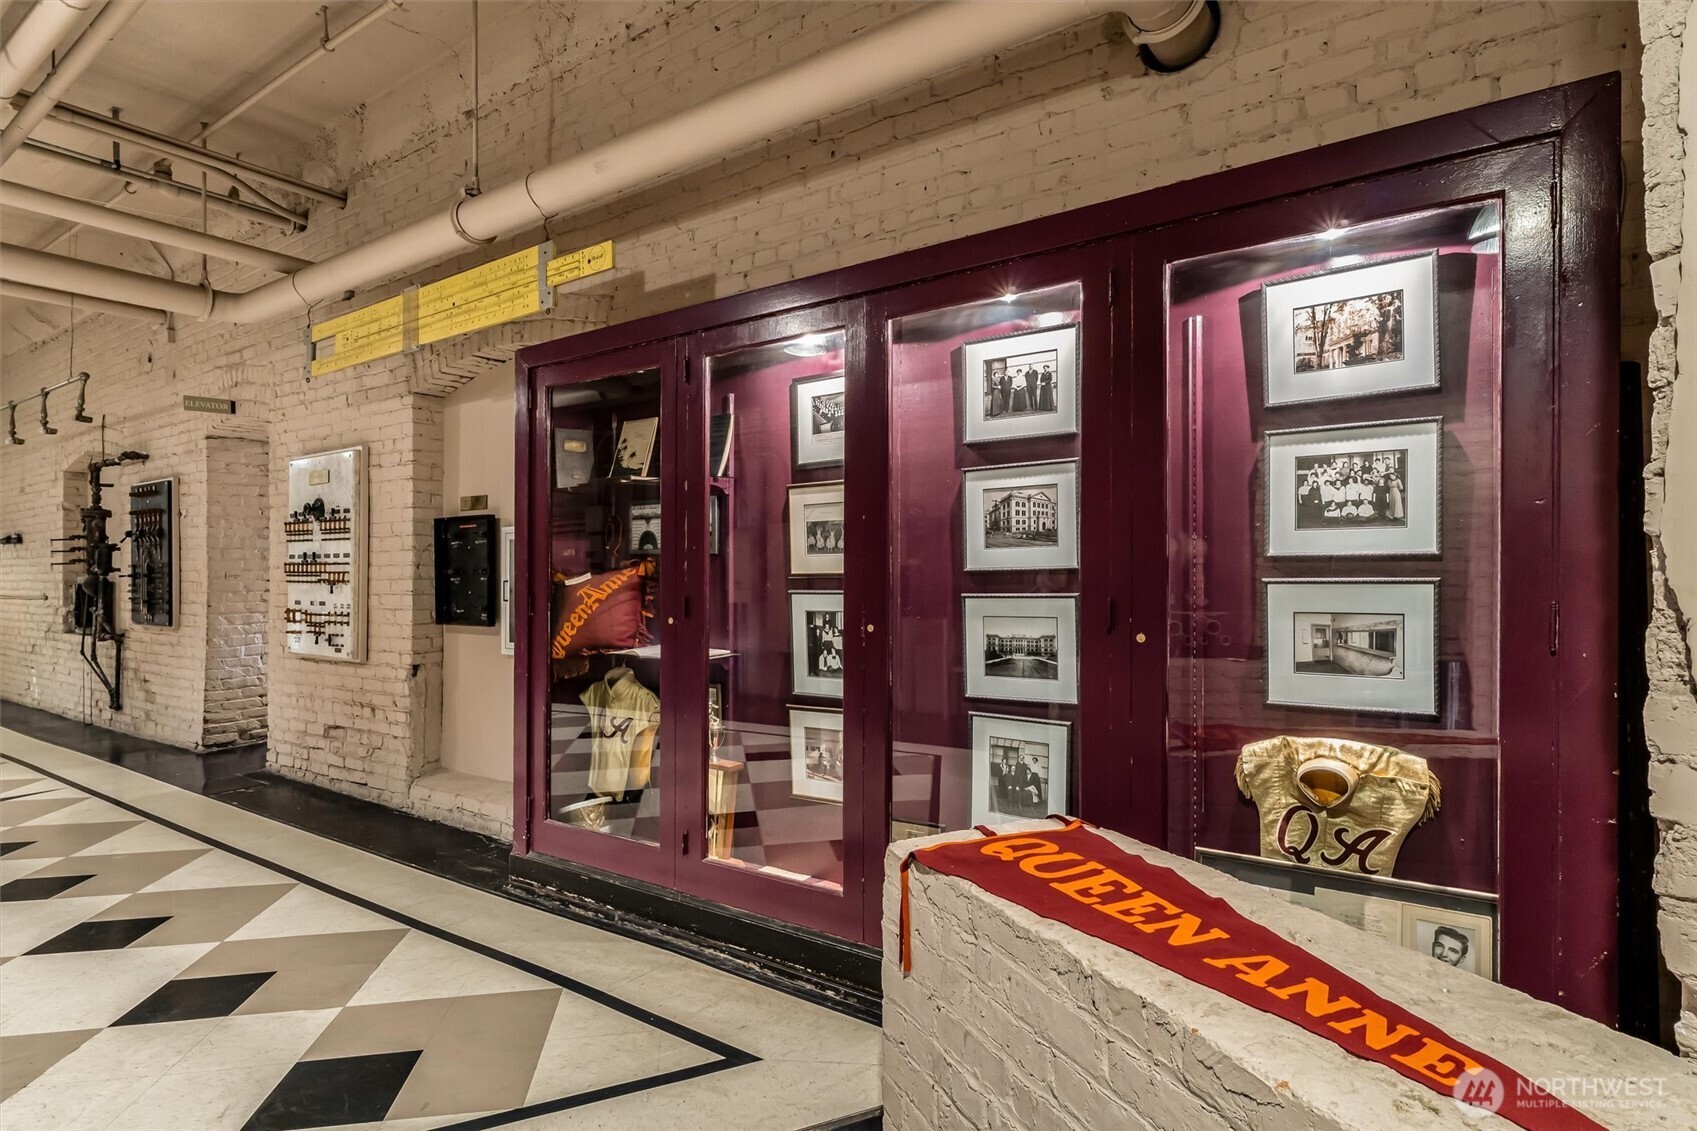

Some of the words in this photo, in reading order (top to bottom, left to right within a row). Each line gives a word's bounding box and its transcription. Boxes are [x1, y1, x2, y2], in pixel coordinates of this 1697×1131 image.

[185, 400, 229, 410] ELEVATOR
[577, 567, 636, 611] Anne
[980, 837, 1231, 947] QUEEN
[1202, 954, 1484, 1087] ANNE
